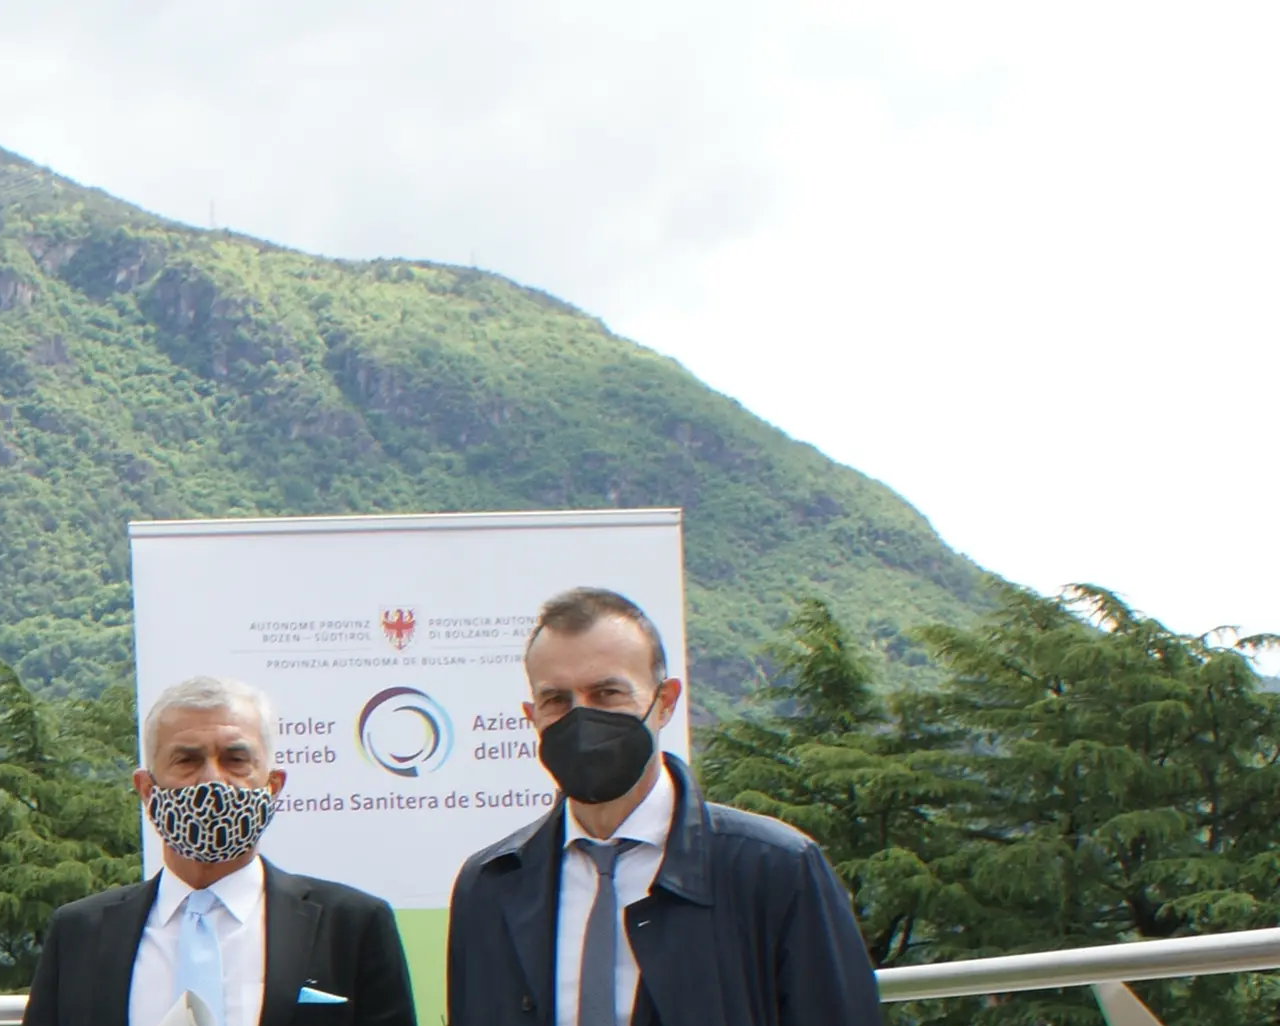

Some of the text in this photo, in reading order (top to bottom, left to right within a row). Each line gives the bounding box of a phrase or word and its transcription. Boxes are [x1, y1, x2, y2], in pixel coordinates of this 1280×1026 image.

[249, 619, 371, 631] AUTONOME PROVINZ
[428, 615, 537, 627] PROVINCIA AUTON
[261, 630, 301, 643] BOZEN
[428, 629, 441, 640] DI
[444, 628, 500, 640] BOLZANO
[266, 658, 330, 669] PROVINZIA
[332, 657, 399, 668] AUTONOMA
[402, 656, 417, 666] DE
[421, 656, 467, 666] BULSAN
[473, 713, 530, 731] Azien
[474, 741, 536, 760] dell’Al
[275, 789, 553, 812] zienda Sanitera de Sudtiro
